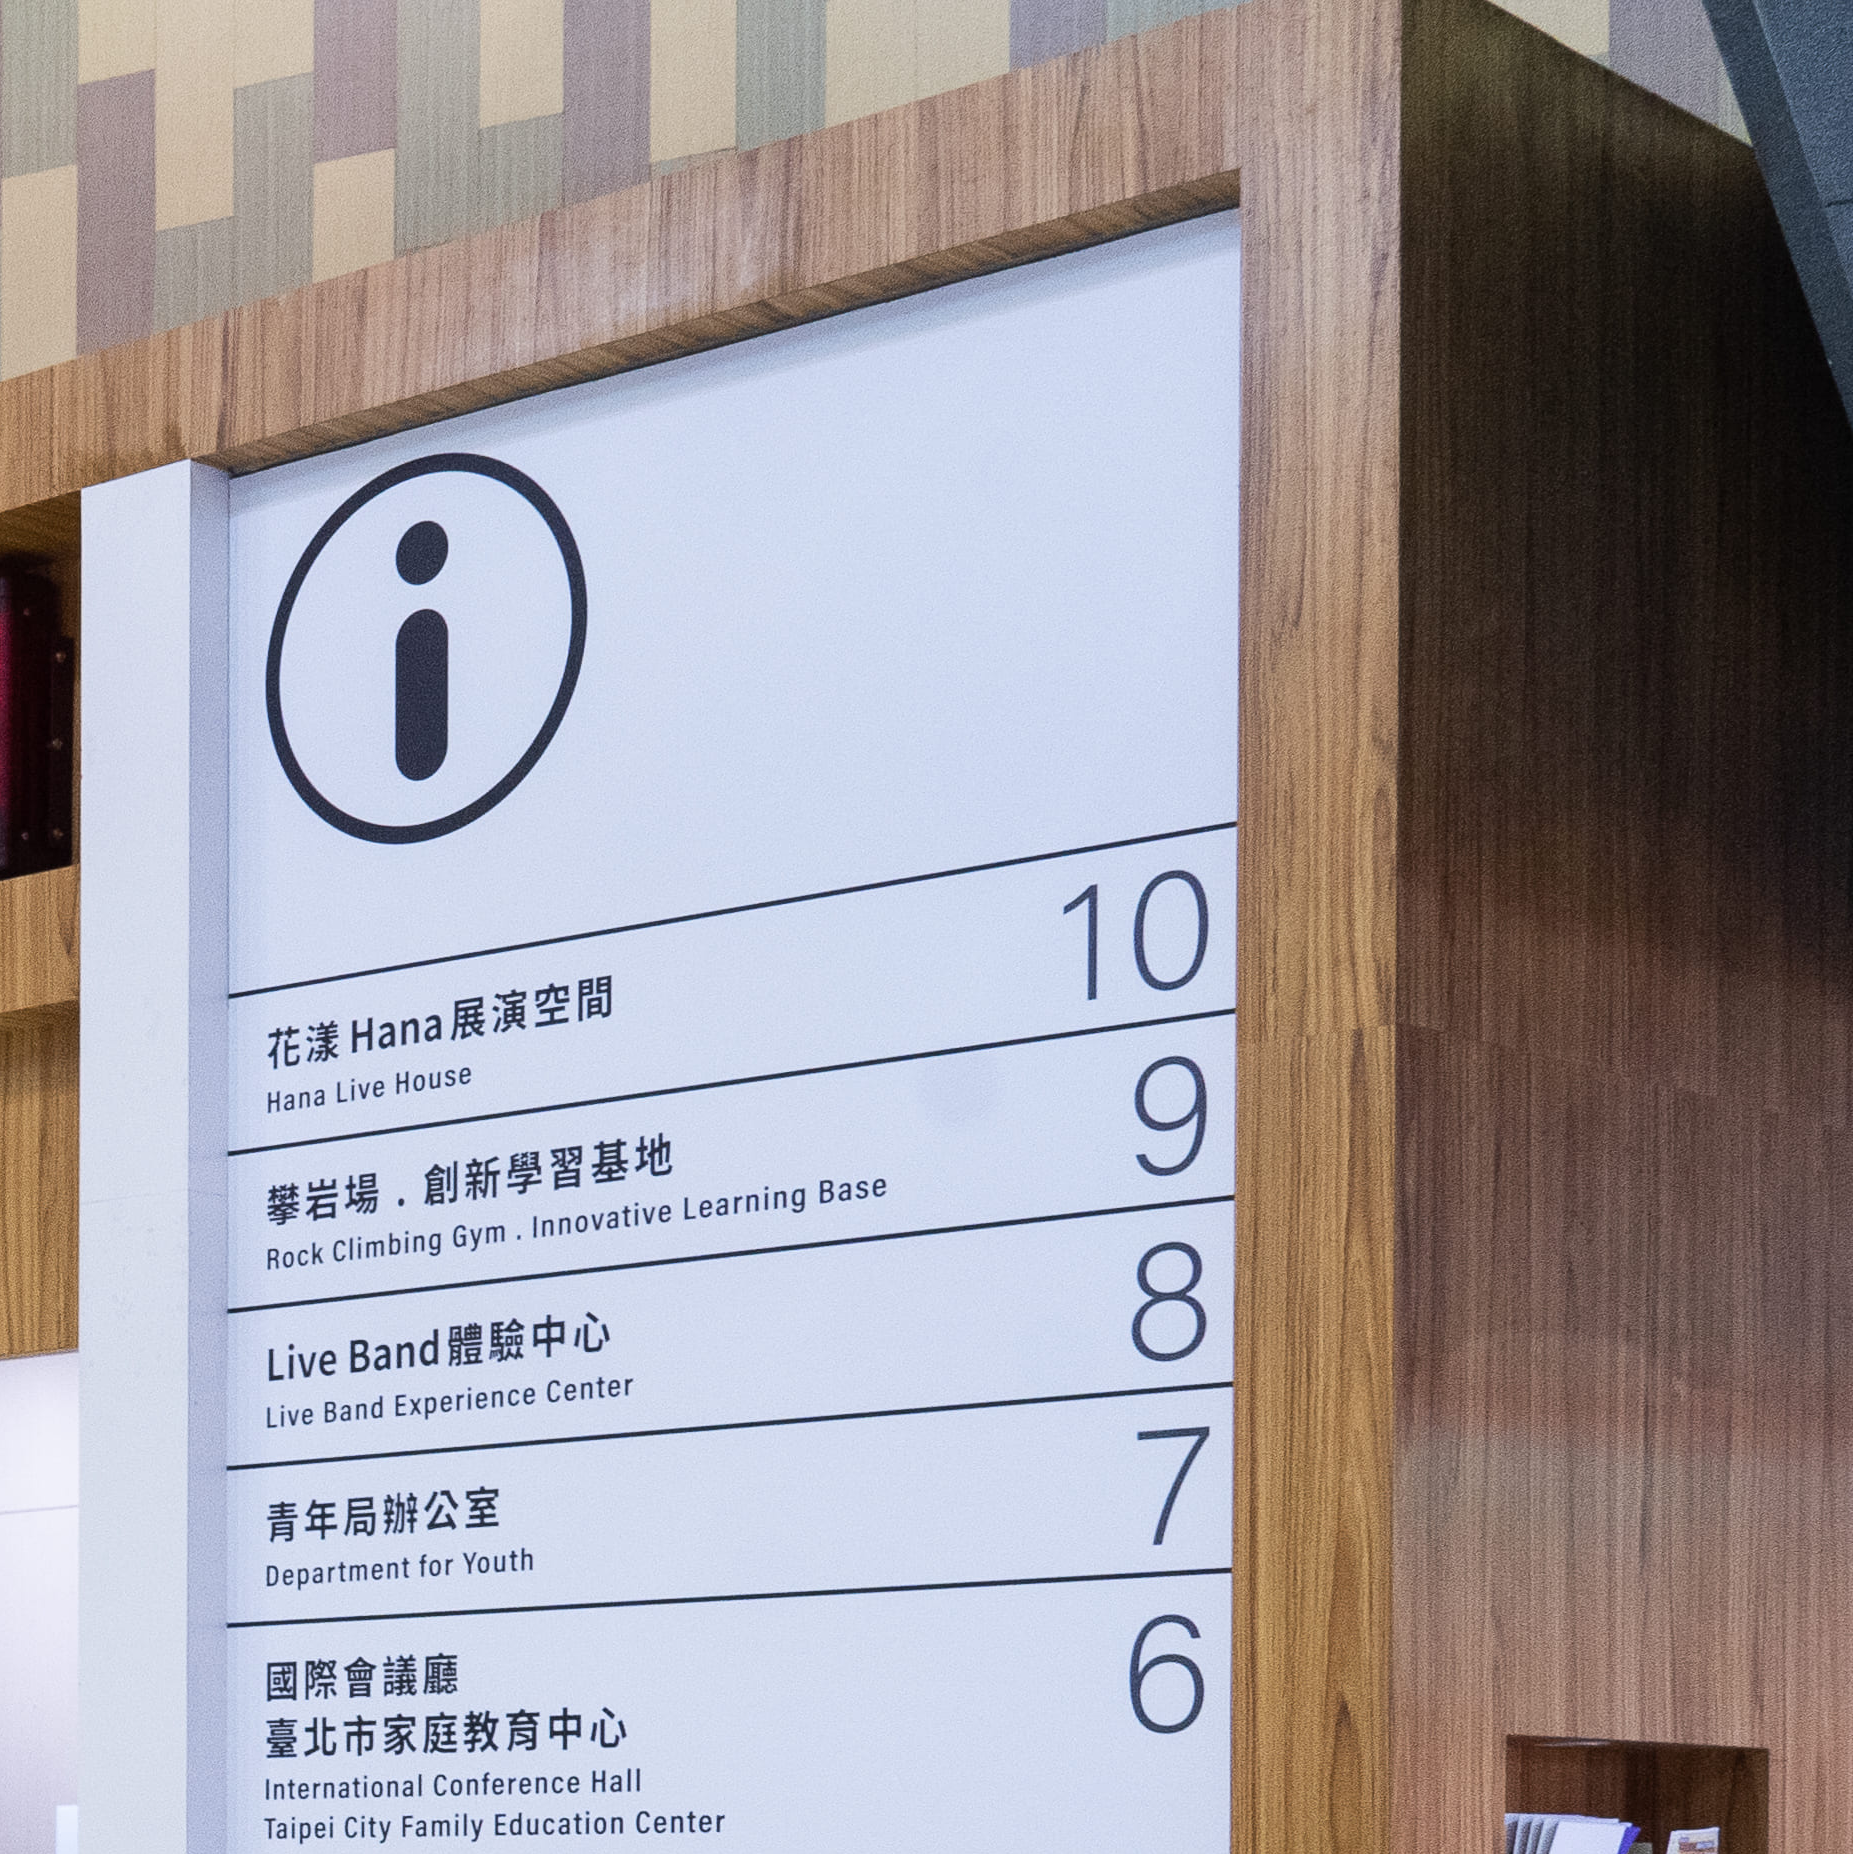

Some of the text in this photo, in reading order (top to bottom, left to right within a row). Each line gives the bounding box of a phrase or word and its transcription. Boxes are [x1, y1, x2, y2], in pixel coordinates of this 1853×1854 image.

[1063, 870, 1209, 1000] 10
[268, 1067, 471, 1113] Hana Live House
[1135, 1056, 1207, 1176] 9
[267, 1243, 323, 1270] Rock
[333, 1231, 441, 1262] Climbing
[453, 1225, 505, 1252] Gym
[533, 1203, 671, 1238] Innovative
[684, 1186, 805, 1220] Learning
[819, 1179, 886, 1204] Base
[1132, 1242, 1207, 1362] 8
[268, 1344, 337, 1381] Live
[267, 1377, 633, 1428] Live Band Experience Center
[1137, 1426, 1210, 1545] 7
[267, 1486, 499, 1542] 青年局辦公室
[266, 1548, 533, 1590] Department for Youth
[267, 1653, 458, 1702] 國際會議廳
[1130, 1614, 1204, 1734] 6
[267, 1707, 627, 1758] 臺北市家庭教育中心
[266, 1768, 640, 1800] International Conference Hall
[264, 1811, 725, 1844] Taipei City Family Education Center
